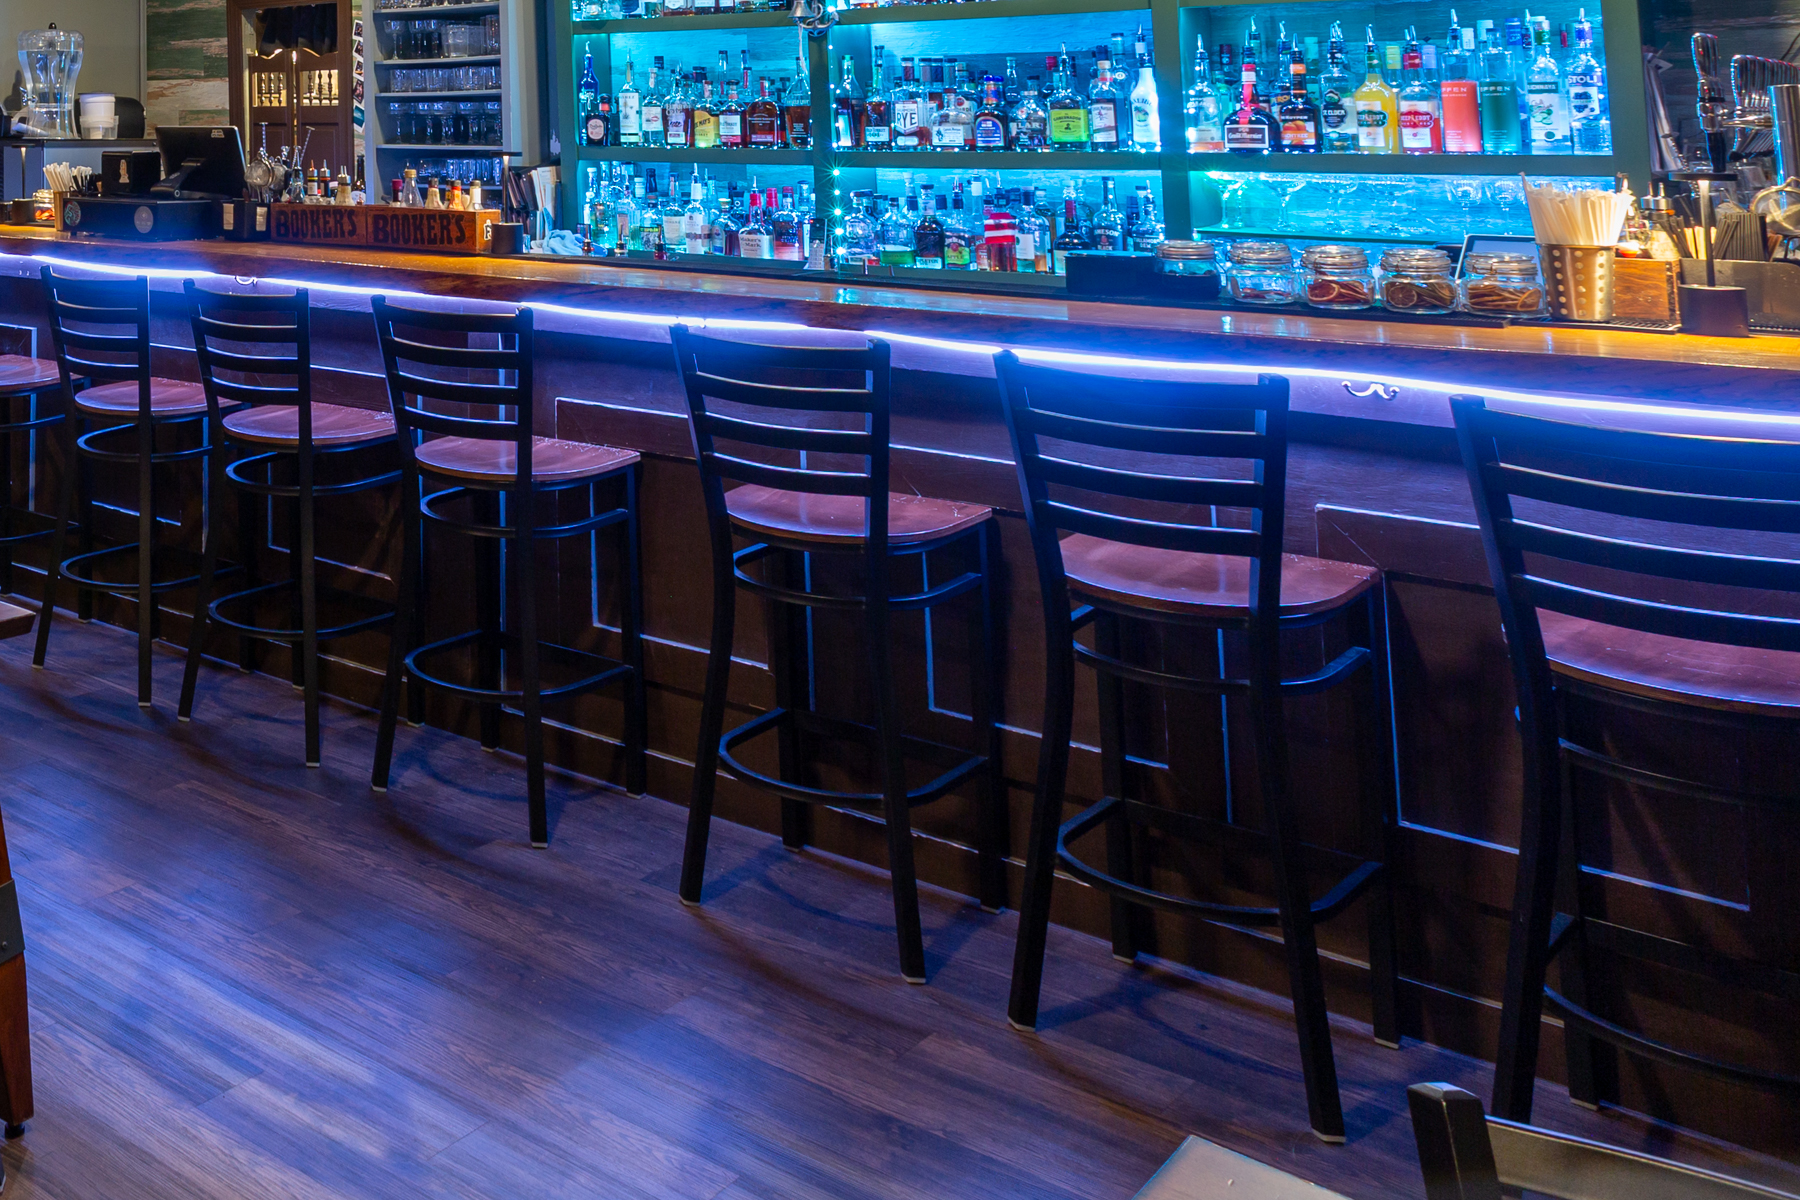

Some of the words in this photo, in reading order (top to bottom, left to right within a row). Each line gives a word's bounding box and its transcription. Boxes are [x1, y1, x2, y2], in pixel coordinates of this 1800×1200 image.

[1568, 75, 1597, 83] STOLI
[897, 113, 917, 128] RYE
[275, 209, 357, 238] BOOKER'S
[372, 213, 466, 245] BOOKER'S
